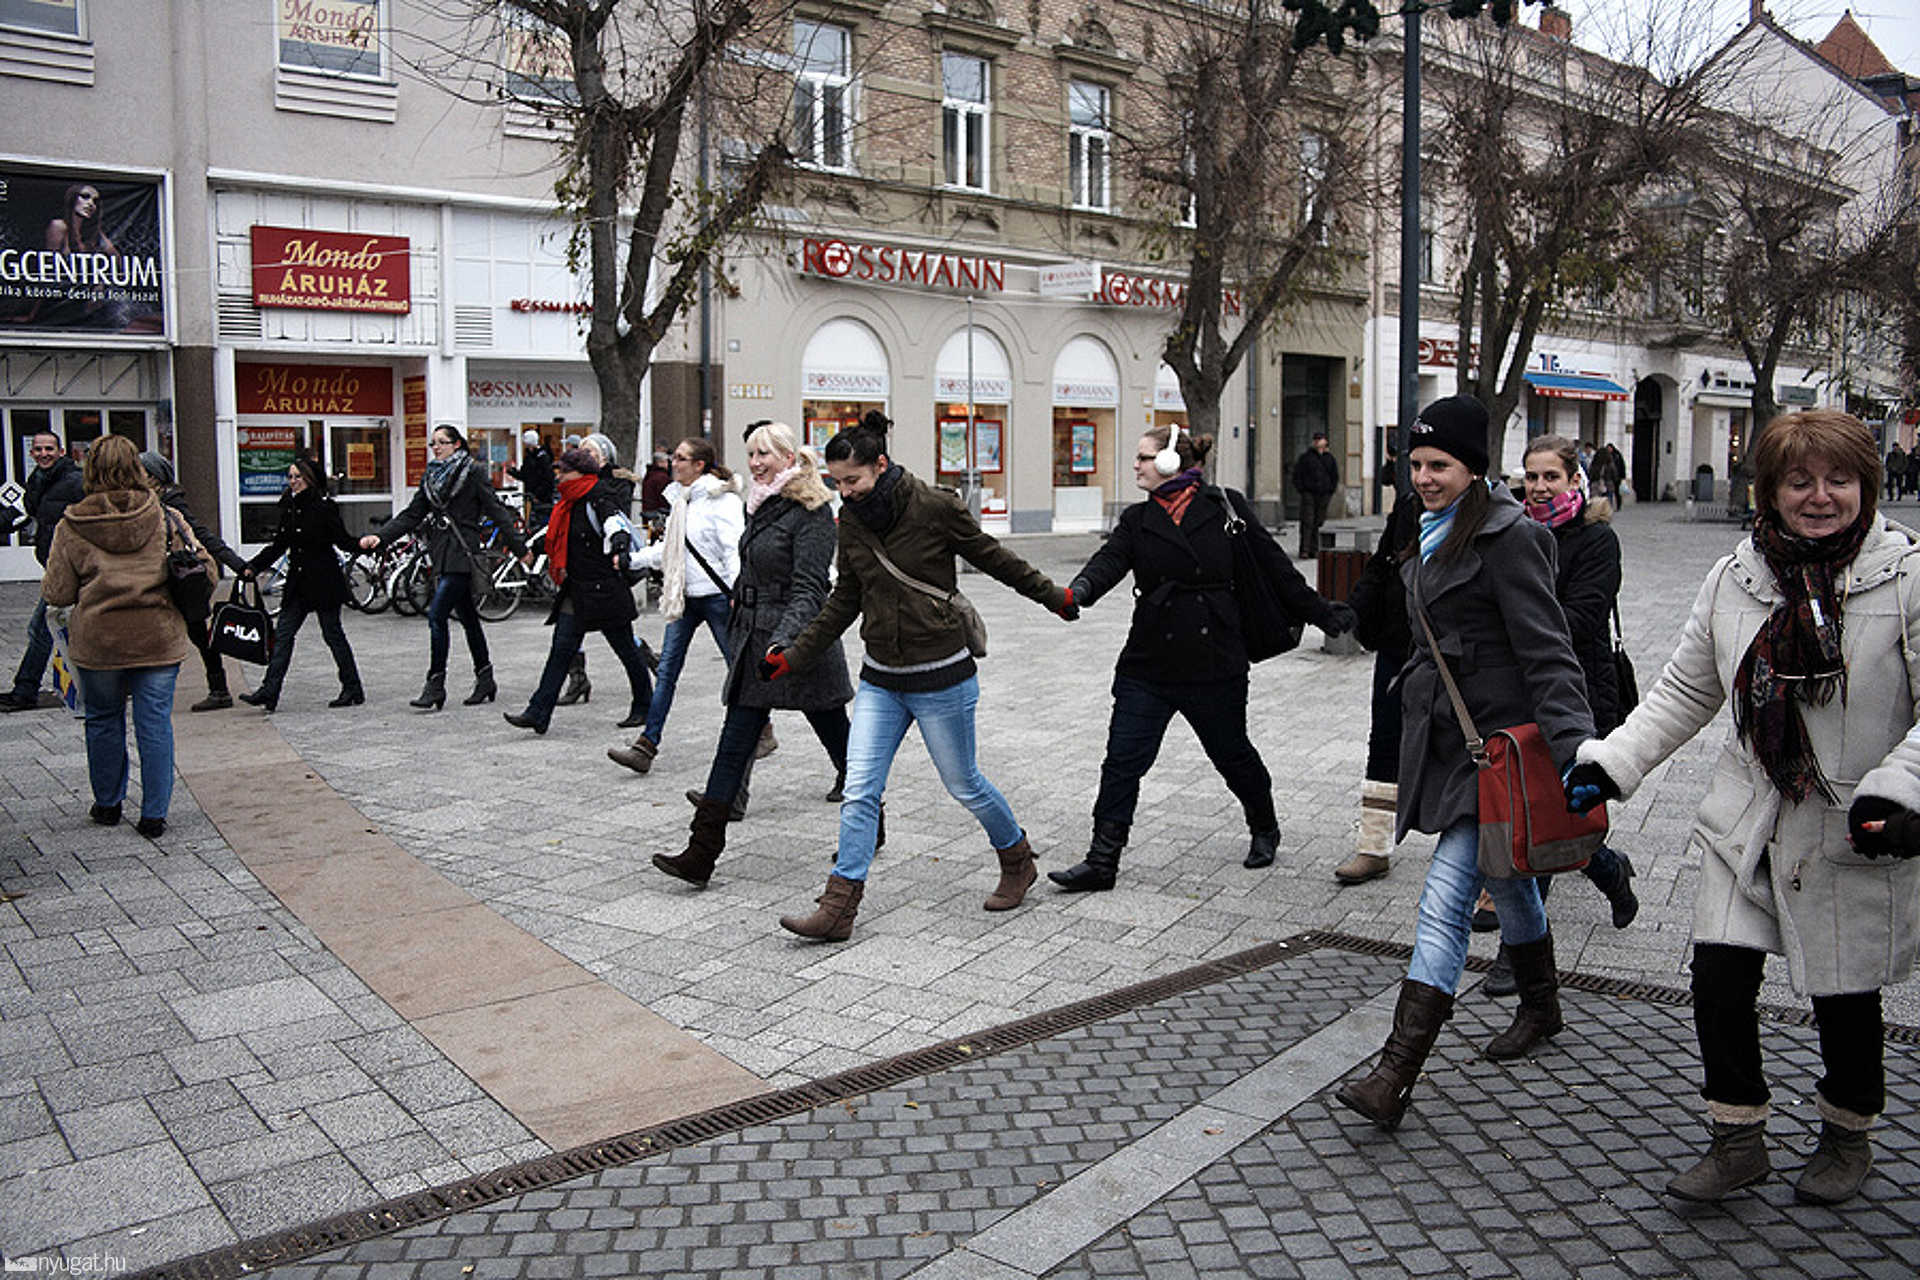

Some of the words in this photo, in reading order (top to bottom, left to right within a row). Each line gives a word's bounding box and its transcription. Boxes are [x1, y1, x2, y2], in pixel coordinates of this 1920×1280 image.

[284, 0, 374, 31] Mondo
[281, 239, 382, 271] Mondo
[803, 238, 1004, 291] ROSSMANN
[281, 268, 388, 297] ÁRUHÁZ
[1093, 272, 1241, 317] ROSSMN
[257, 367, 360, 396] Mondo
[468, 381, 572, 398] ROSSMANN
[263, 395, 354, 413] ÁRUHÁZ
[223, 621, 261, 642] FILA
